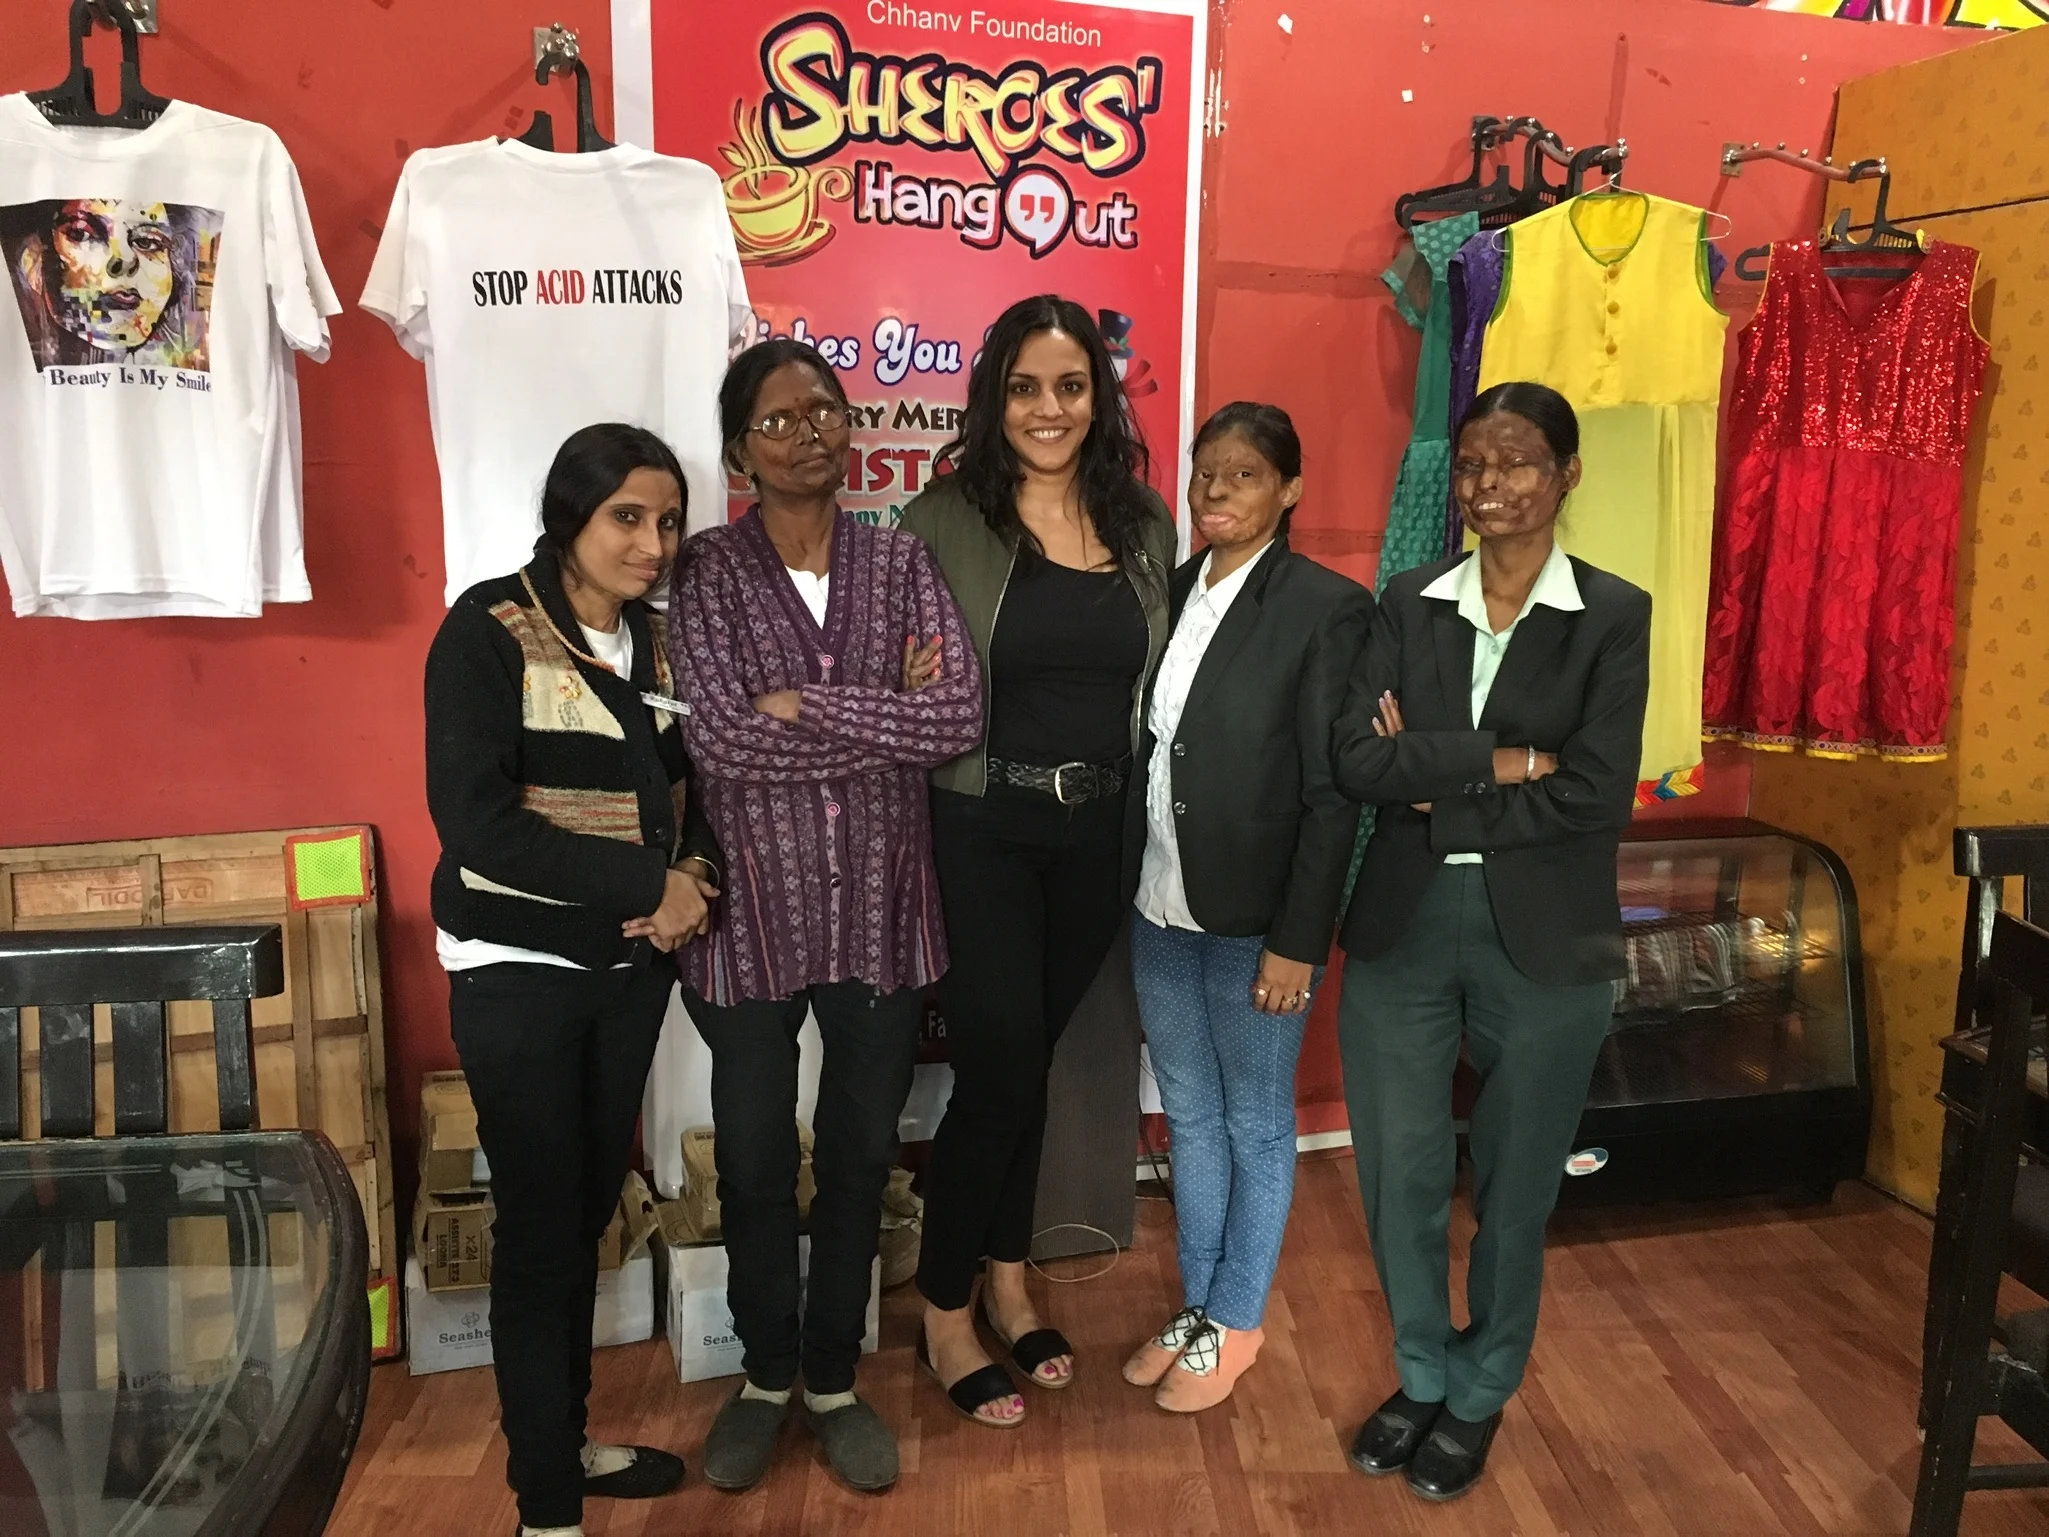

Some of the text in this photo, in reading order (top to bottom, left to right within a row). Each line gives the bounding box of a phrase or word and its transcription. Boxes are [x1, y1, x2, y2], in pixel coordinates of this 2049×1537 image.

[867, 0, 1101, 47] Chhanv Foundation
[472, 269, 683, 307] STOP ACID ATTACKS
[872, 315, 963, 386] You
[49, 366, 212, 392] Beauty Is My Smile
